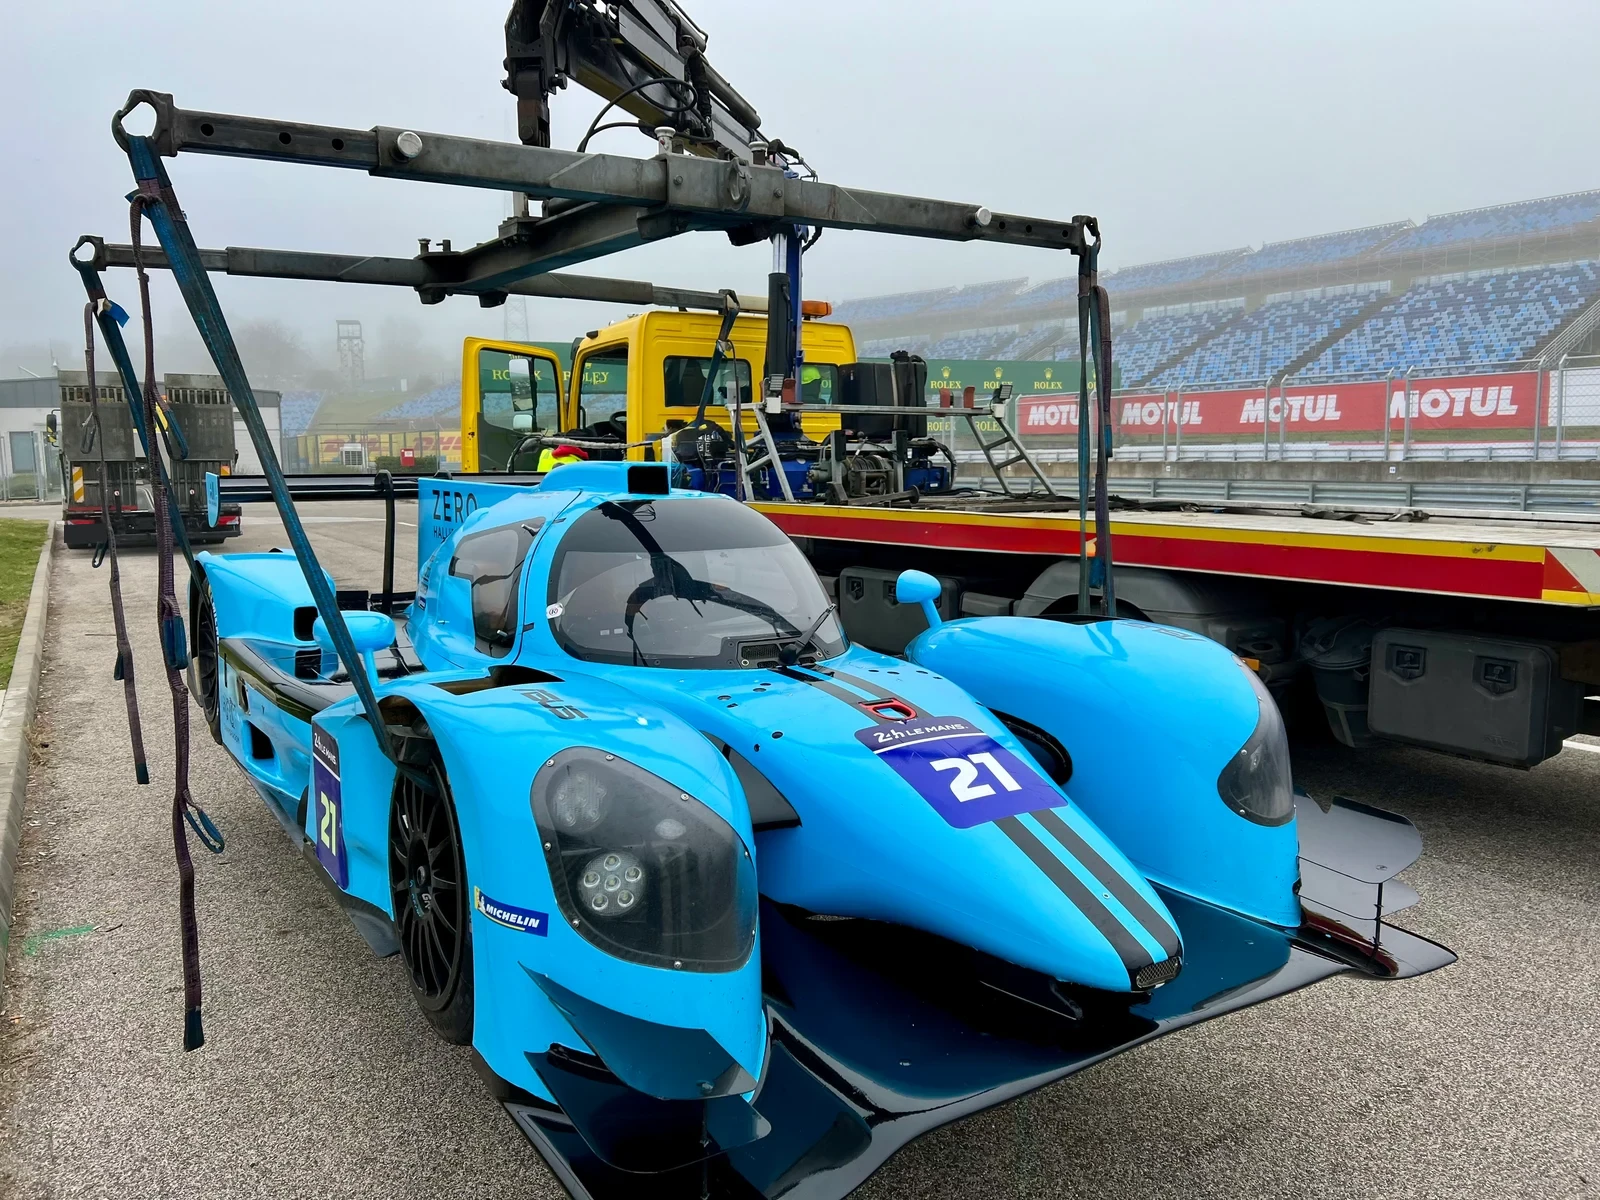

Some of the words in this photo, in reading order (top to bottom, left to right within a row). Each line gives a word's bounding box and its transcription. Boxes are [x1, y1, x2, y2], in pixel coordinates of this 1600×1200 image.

[492, 369, 542, 381] ROX
[930, 380, 962, 389] ROLEX
[983, 381, 1013, 389] ROL
[1034, 381, 1063, 390] ROLEX
[1121, 401, 1203, 425] MOTUL
[1239, 394, 1341, 424] MOTUL
[1390, 386, 1518, 418] MOTUL
[1028, 404, 1079, 426] MOTU
[432, 489, 478, 523] ZERO
[906, 727, 925, 736] LE
[929, 752, 1023, 803] 21
[320, 791, 336, 857] 21
[486, 903, 540, 928] MICHELIN
